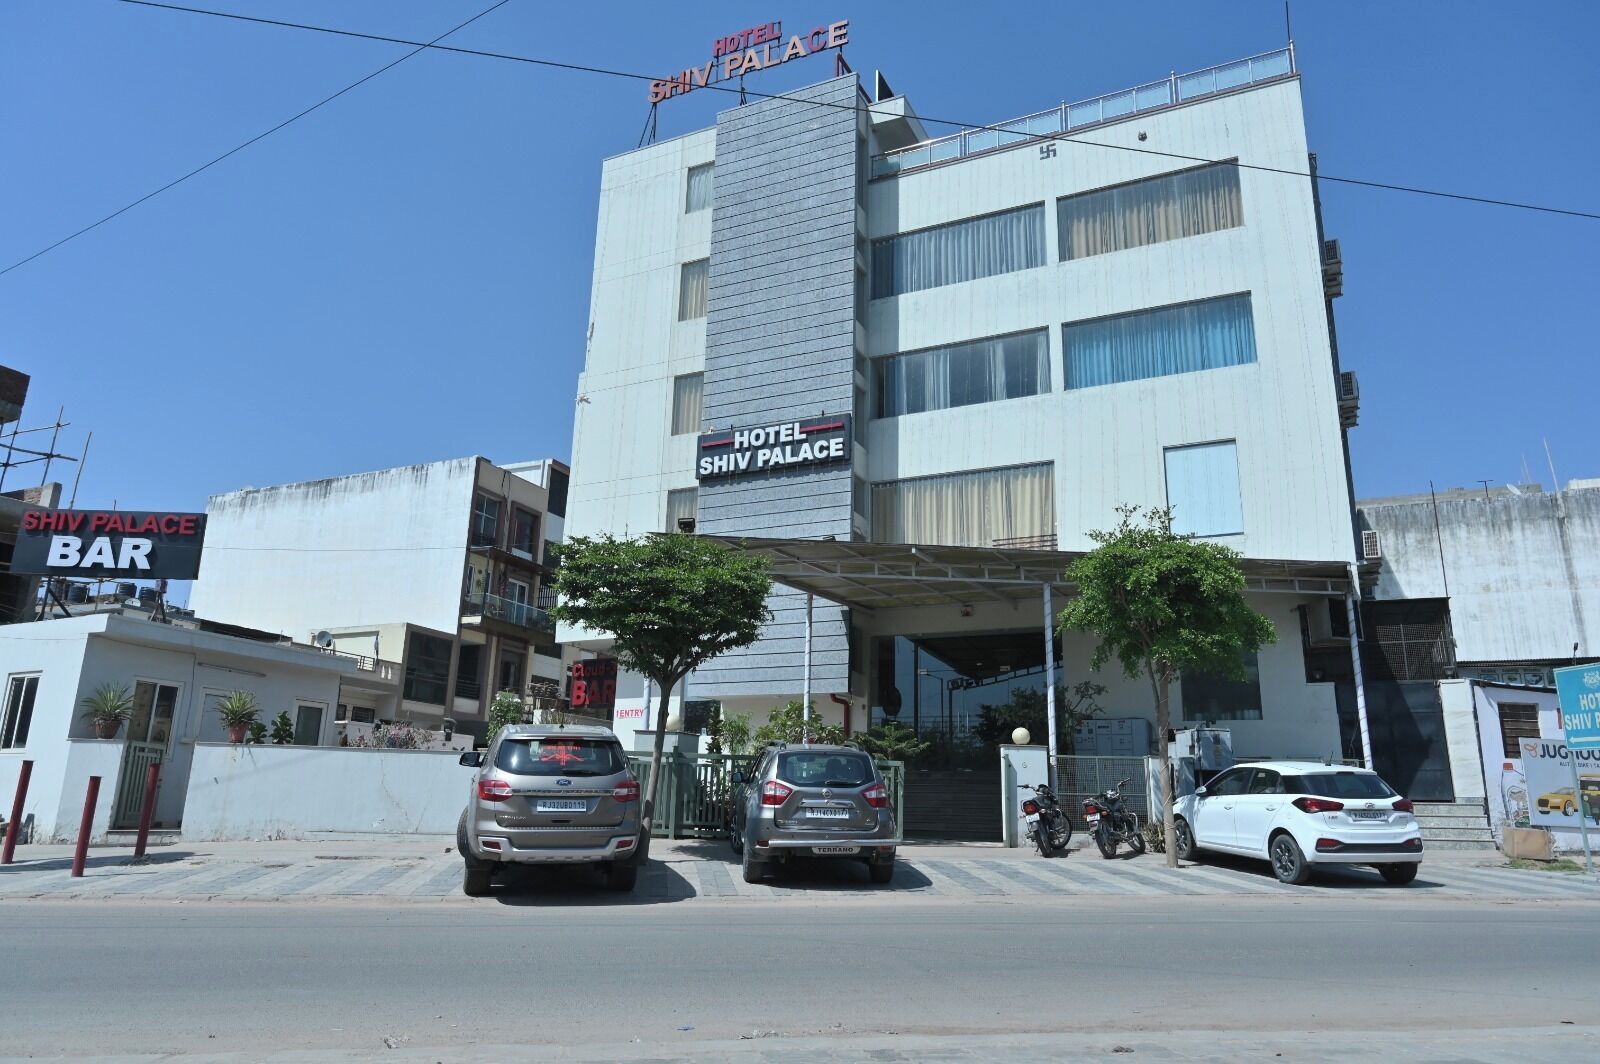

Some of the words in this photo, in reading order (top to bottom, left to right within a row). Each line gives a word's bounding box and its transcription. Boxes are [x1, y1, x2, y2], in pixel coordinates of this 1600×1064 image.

[713, 21, 782, 57] HOTEL
[648, 61, 713, 103] SHIV
[724, 19, 848, 79] PALACE
[734, 422, 807, 449] HOTEL
[700, 451, 752, 475] SHIV
[757, 437, 844, 467] PALACE
[22, 510, 85, 532] SHIV
[90, 513, 198, 535] PALACE
[46, 535, 153, 570] BAR
[571, 680, 616, 706] BAR
[619, 708, 644, 719] ENTRY
[1564, 713, 1592, 731] SHIV
